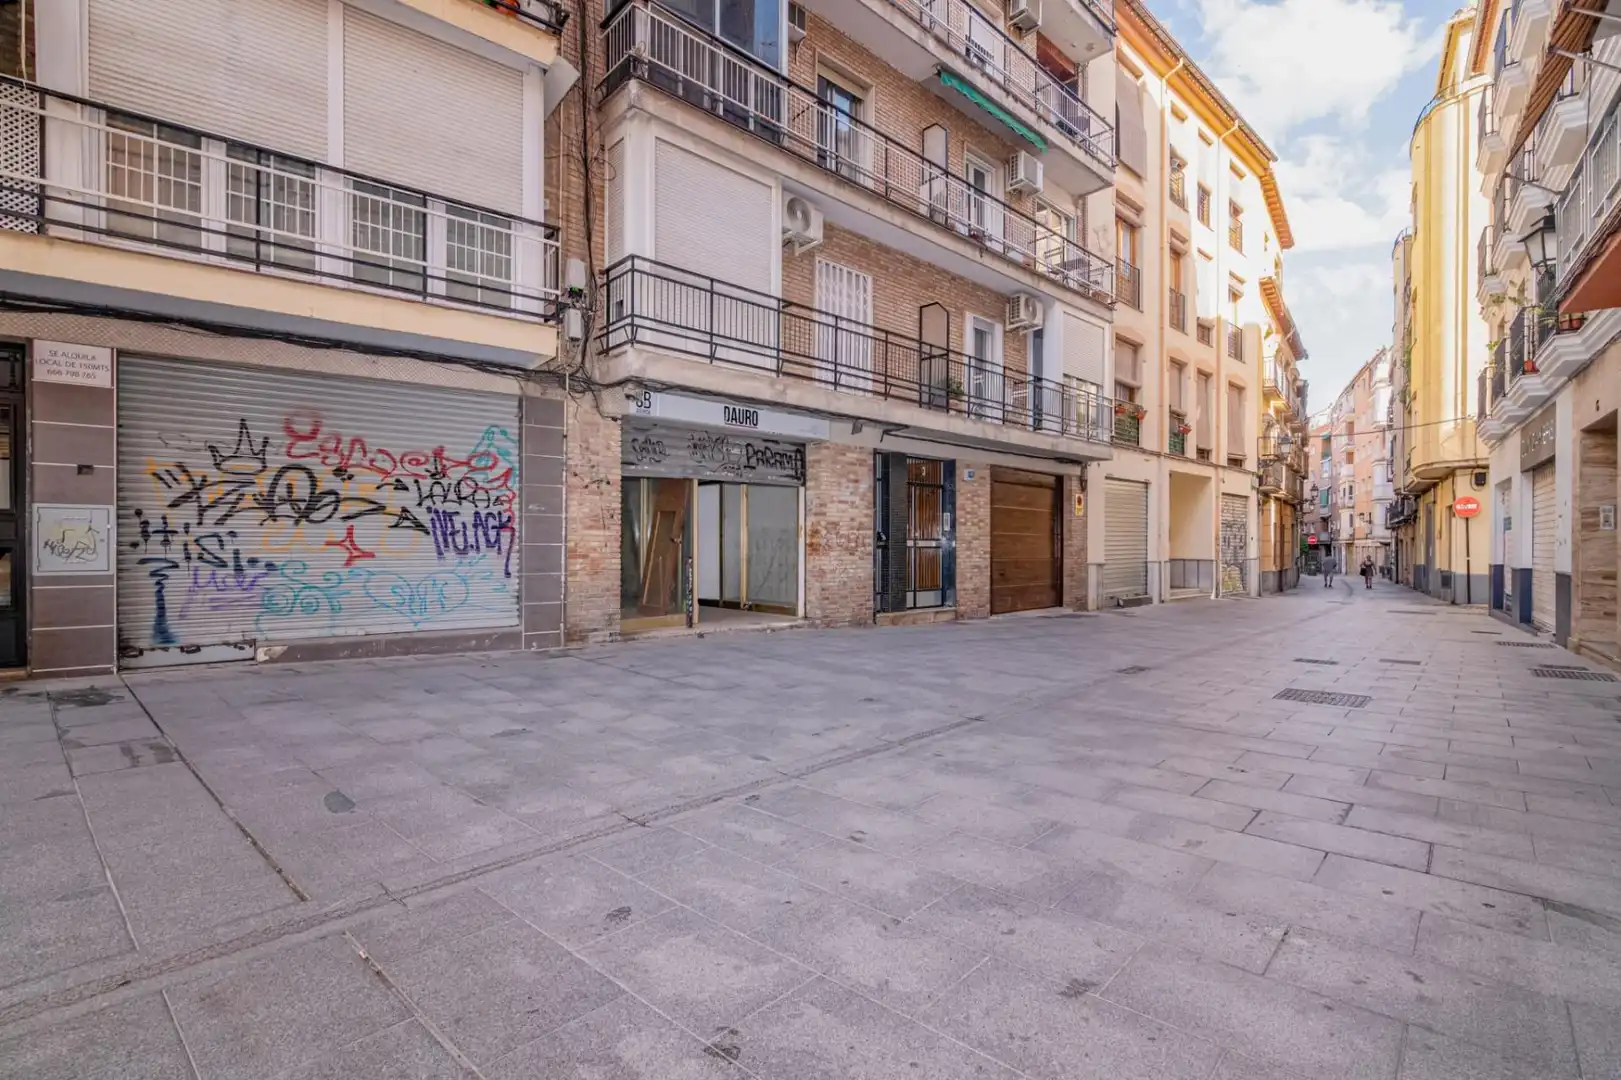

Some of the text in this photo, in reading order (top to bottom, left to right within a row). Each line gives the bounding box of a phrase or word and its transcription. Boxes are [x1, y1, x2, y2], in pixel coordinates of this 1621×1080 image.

[61, 351, 97, 361] ALQUILA
[35, 358, 62, 367] LOCAL
[724, 405, 758, 427] DAURO
